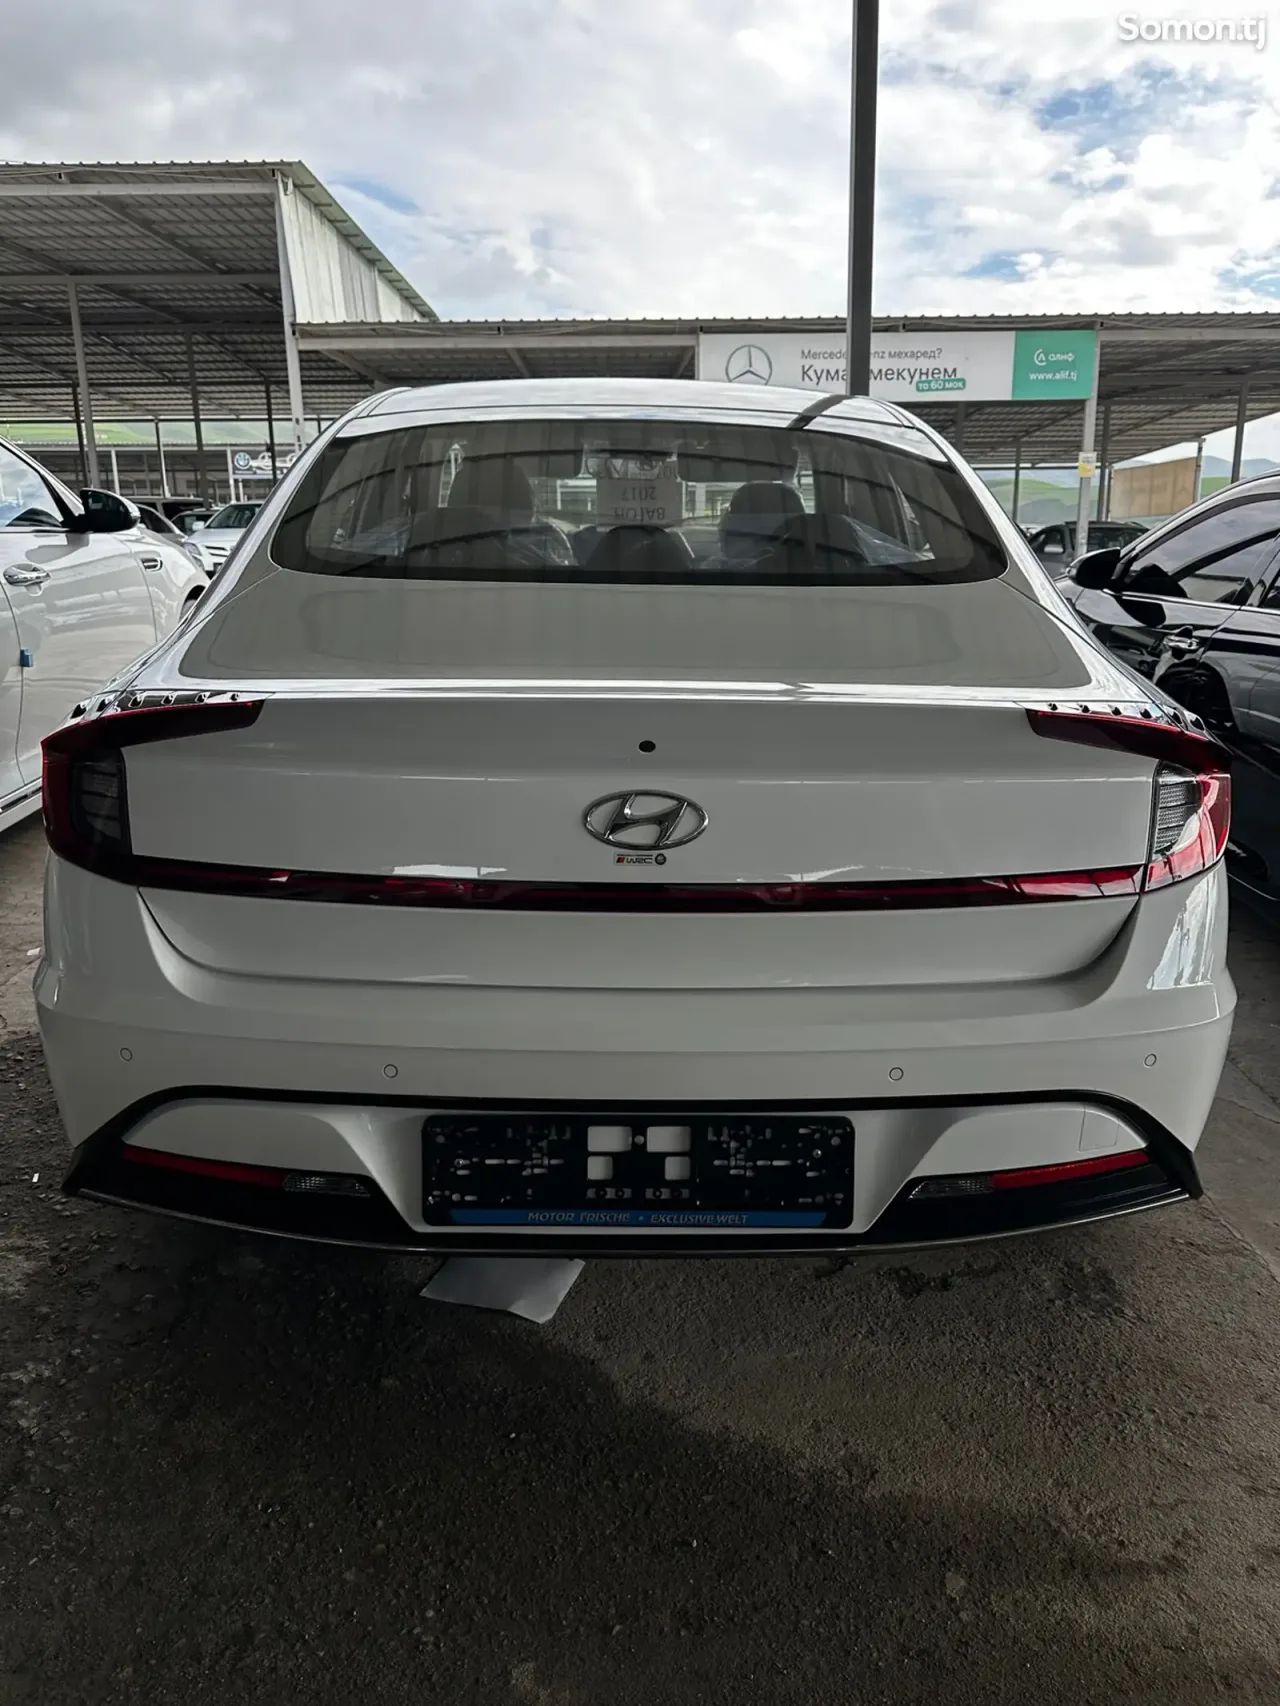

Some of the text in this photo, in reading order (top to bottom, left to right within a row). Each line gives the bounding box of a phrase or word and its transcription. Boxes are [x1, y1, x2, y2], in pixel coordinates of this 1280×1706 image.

[888, 347, 943, 361] мехаред?
[801, 364, 958, 386] Кума мекунем
[1029, 370, 1078, 382] www.alif.tj
[930, 380, 944, 390] 60
[528, 1212, 575, 1222] MOTOR
